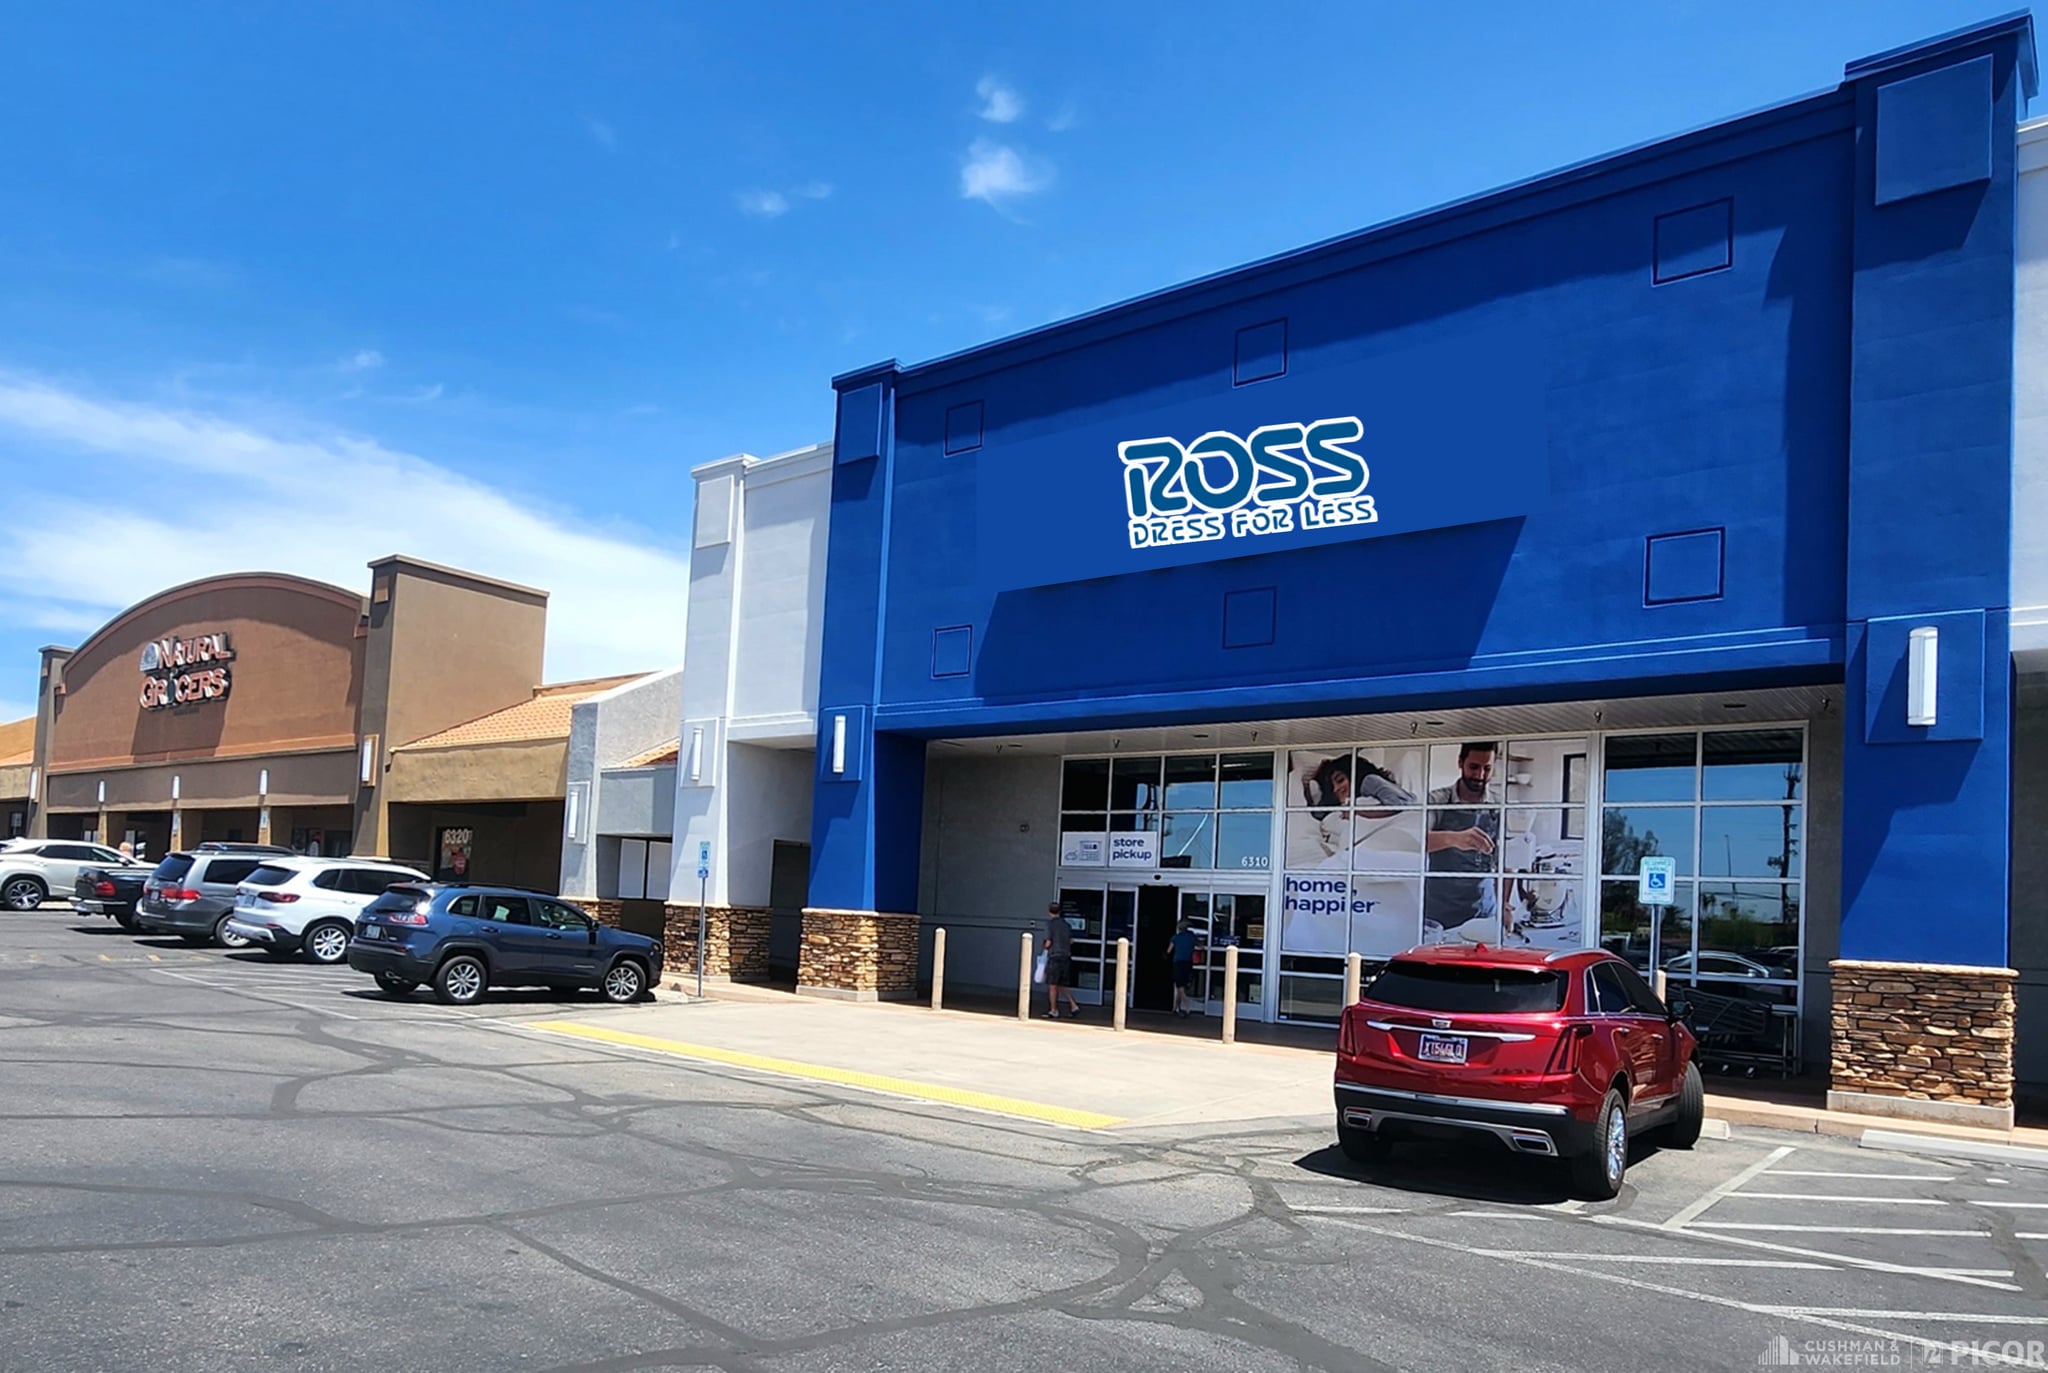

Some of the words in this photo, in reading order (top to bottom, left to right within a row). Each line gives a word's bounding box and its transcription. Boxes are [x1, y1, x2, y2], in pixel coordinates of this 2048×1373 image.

[1118, 416, 1370, 520] ROSS
[1129, 511, 1225, 549] DRESS
[1232, 505, 1294, 538] FOR
[1300, 495, 1379, 530] LESS
[159, 633, 232, 669] NATURAL
[445, 828, 469, 844] 6320
[1113, 838, 1145, 848] store
[1112, 849, 1152, 861] pickup
[1241, 856, 1269, 867] 6310
[1286, 877, 1358, 896] home,
[1285, 895, 1375, 915] happier
